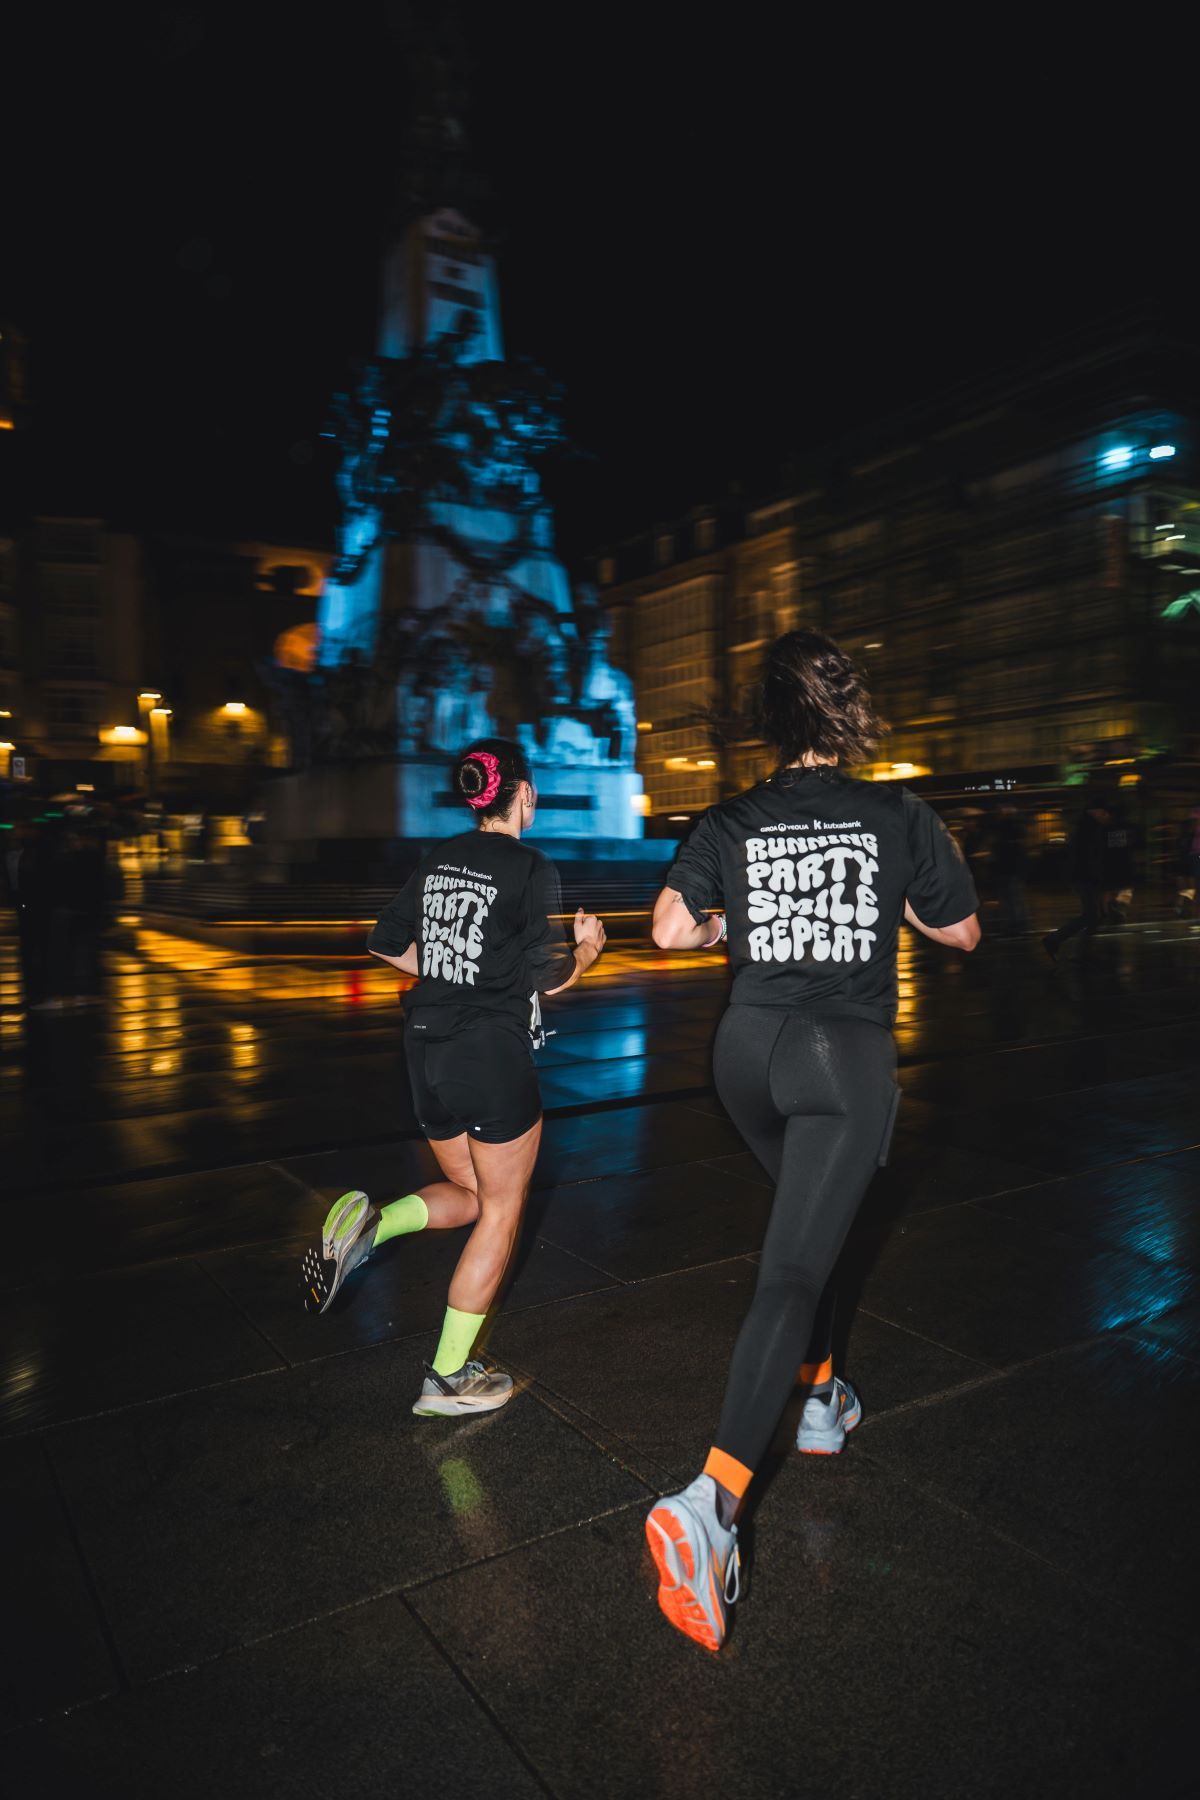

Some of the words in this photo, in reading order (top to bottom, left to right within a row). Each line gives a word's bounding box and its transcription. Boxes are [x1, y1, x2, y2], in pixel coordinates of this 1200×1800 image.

[823, 820, 862, 830] kutxabank
[745, 833, 878, 863] RUNNING
[746, 847, 879, 892] PARTY
[422, 891, 489, 926] PARTY
[424, 874, 498, 906] RUNNING
[747, 881, 879, 927] SMILE
[422, 916, 484, 960] SMILE
[748, 916, 877, 962] REPEAT
[422, 941, 480, 986] EPEAT
